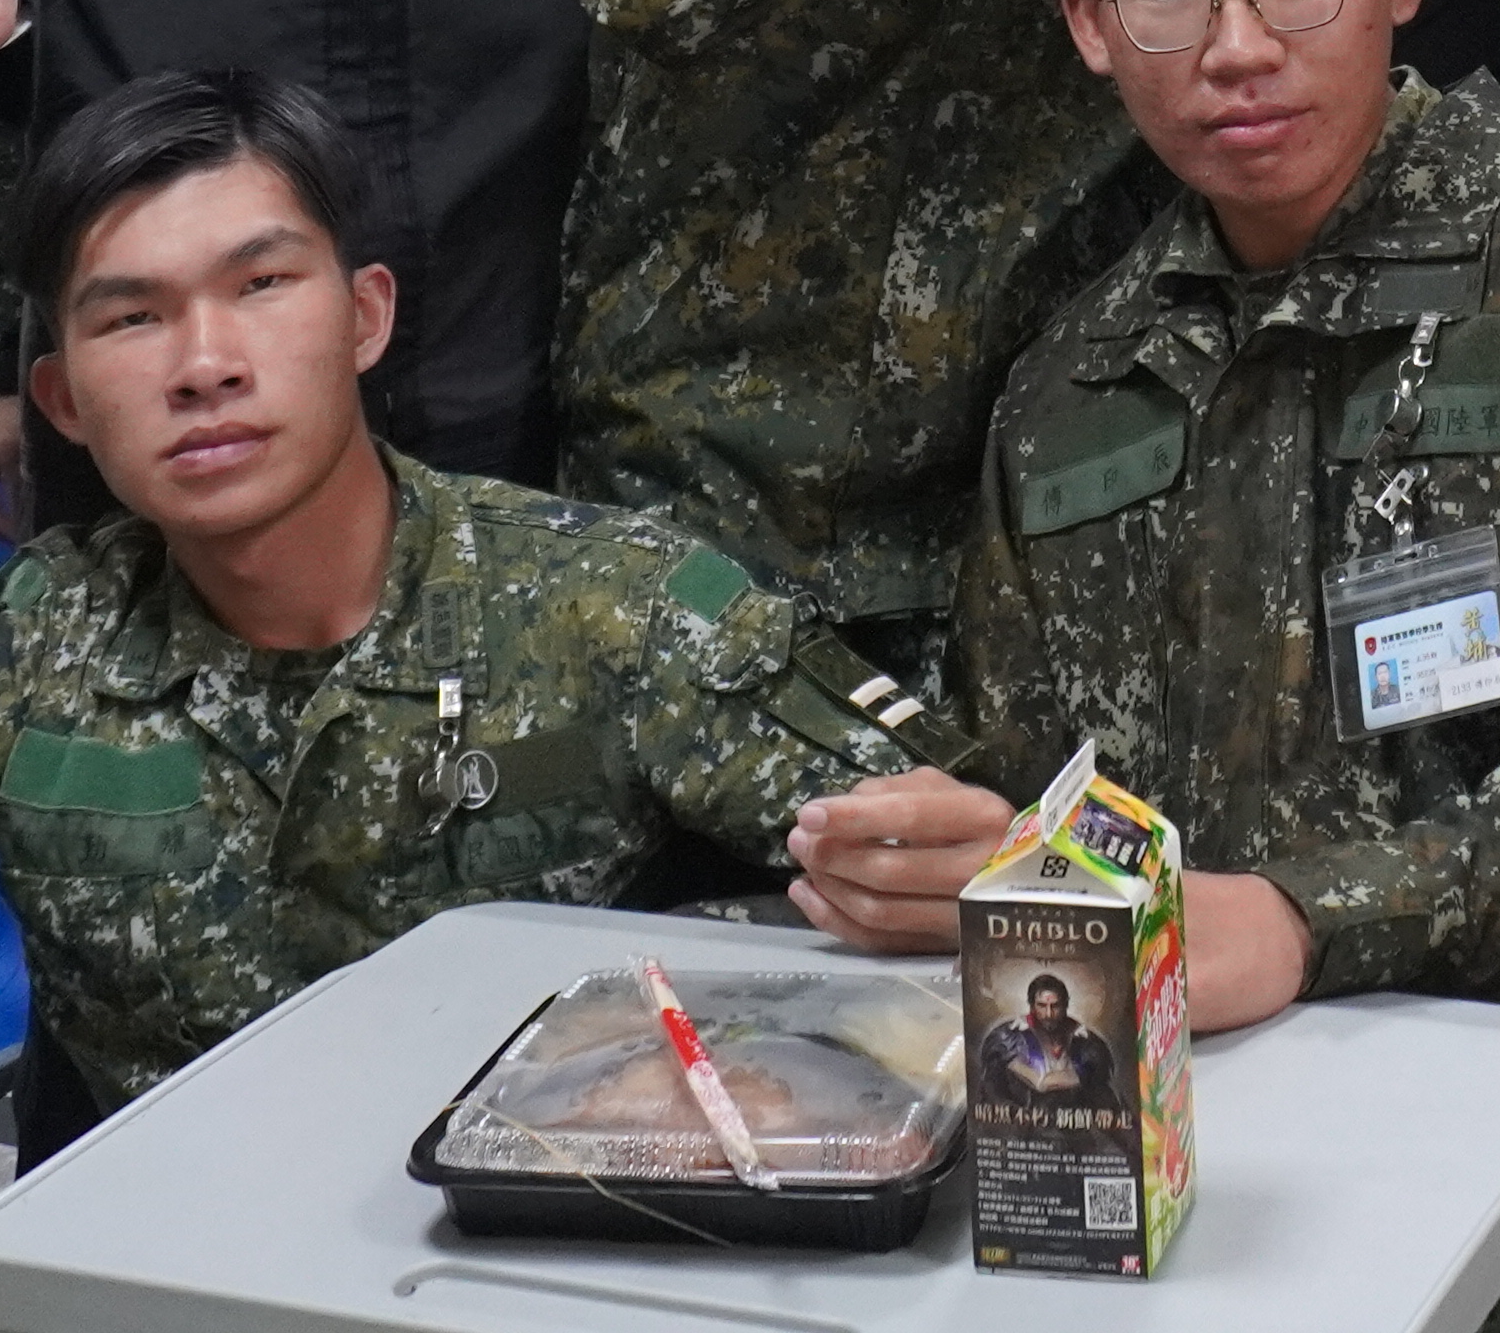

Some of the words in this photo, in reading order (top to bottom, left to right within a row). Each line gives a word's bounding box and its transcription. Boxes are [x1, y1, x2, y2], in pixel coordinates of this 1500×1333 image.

[1354, 403, 1500, 440] 中國陸軍
[987, 913, 1109, 945] DIABLO
